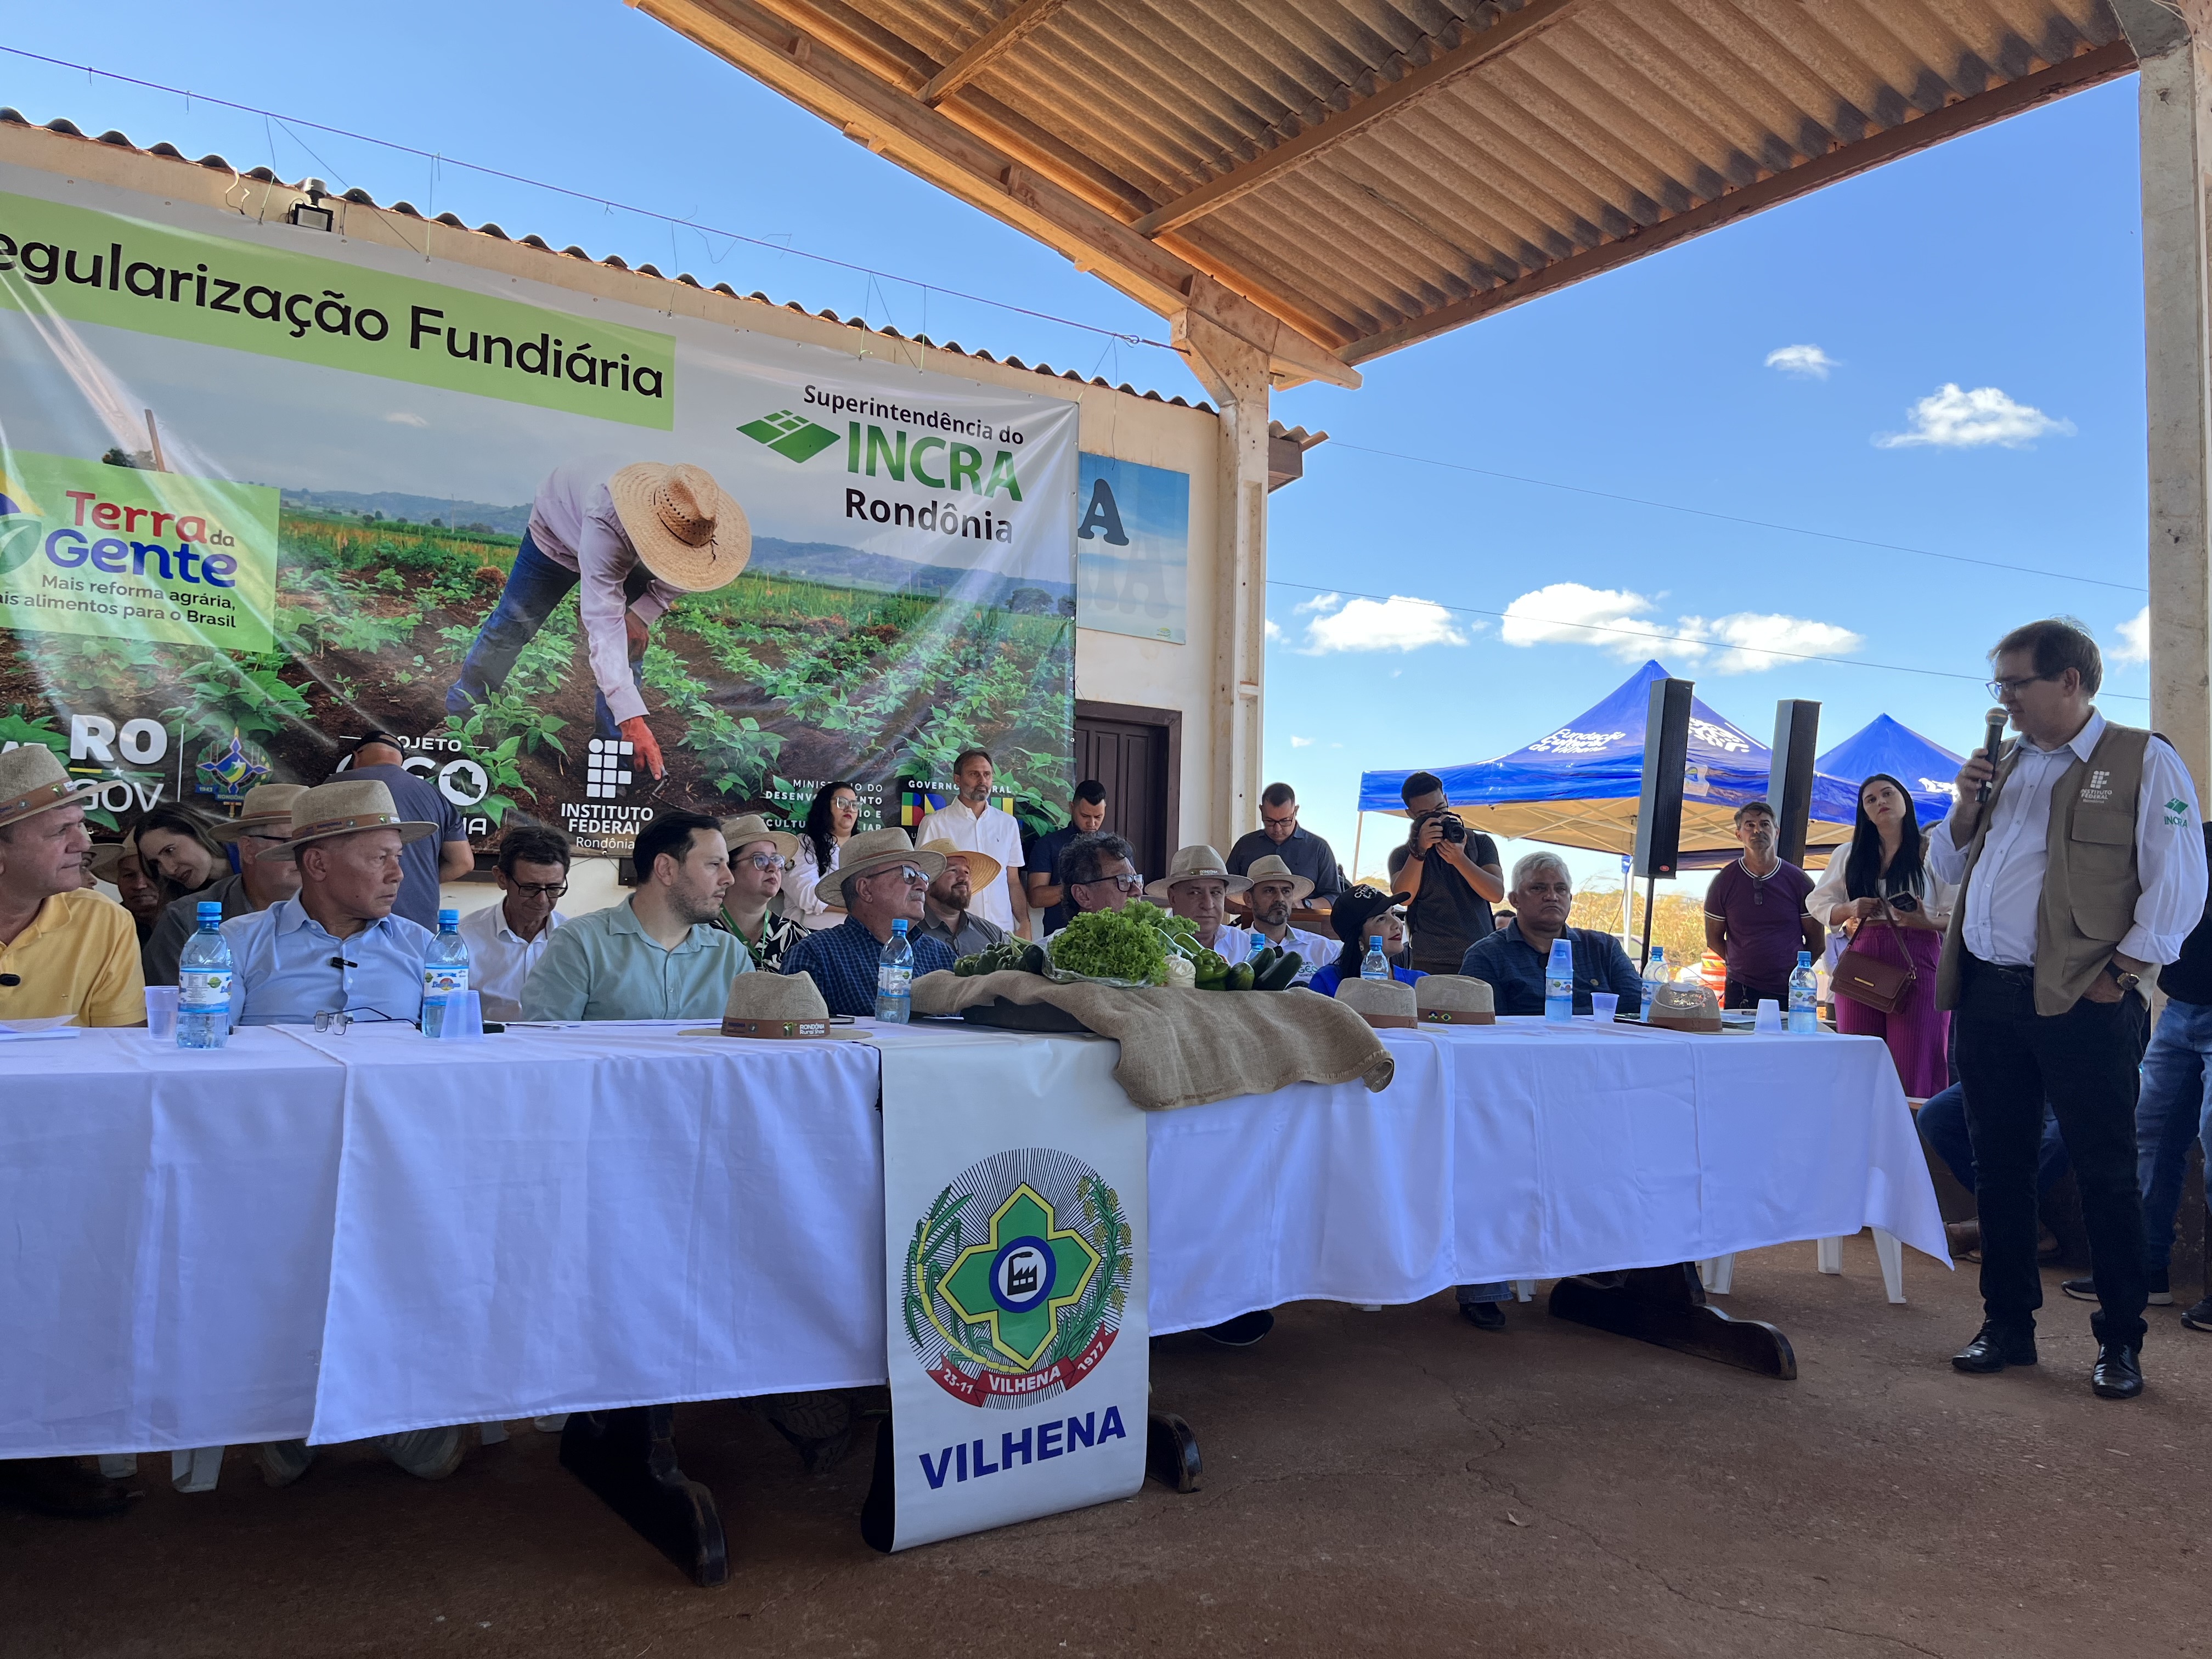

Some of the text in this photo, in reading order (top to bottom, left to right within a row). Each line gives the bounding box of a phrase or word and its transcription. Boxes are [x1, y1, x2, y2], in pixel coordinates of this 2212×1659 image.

[410, 305, 663, 398] Fundiária
[803, 384, 1024, 445] Superintendência do
[847, 420, 1023, 502] INCRA
[66, 490, 235, 547] Terra da
[845, 488, 1013, 544] Rondônia
[45, 528, 238, 588] Gente
[24, 595, 118, 615] alimentos
[123, 606, 165, 619] para
[171, 611, 181, 622] o
[187, 610, 236, 628] Brasil
[42, 574, 236, 611] Mais reforma agrária,
[70, 714, 167, 764] RO
[561, 803, 654, 821] INSTITUTO
[867, 783, 883, 792] DO
[876, 810, 882, 819] E
[2164, 816, 2188, 828] INCRA
[576, 836, 635, 850] Rondônia
[943, 1341, 1104, 1395] 23-11 VILHENA 1977
[919, 1406, 1126, 1490] VILHENA
